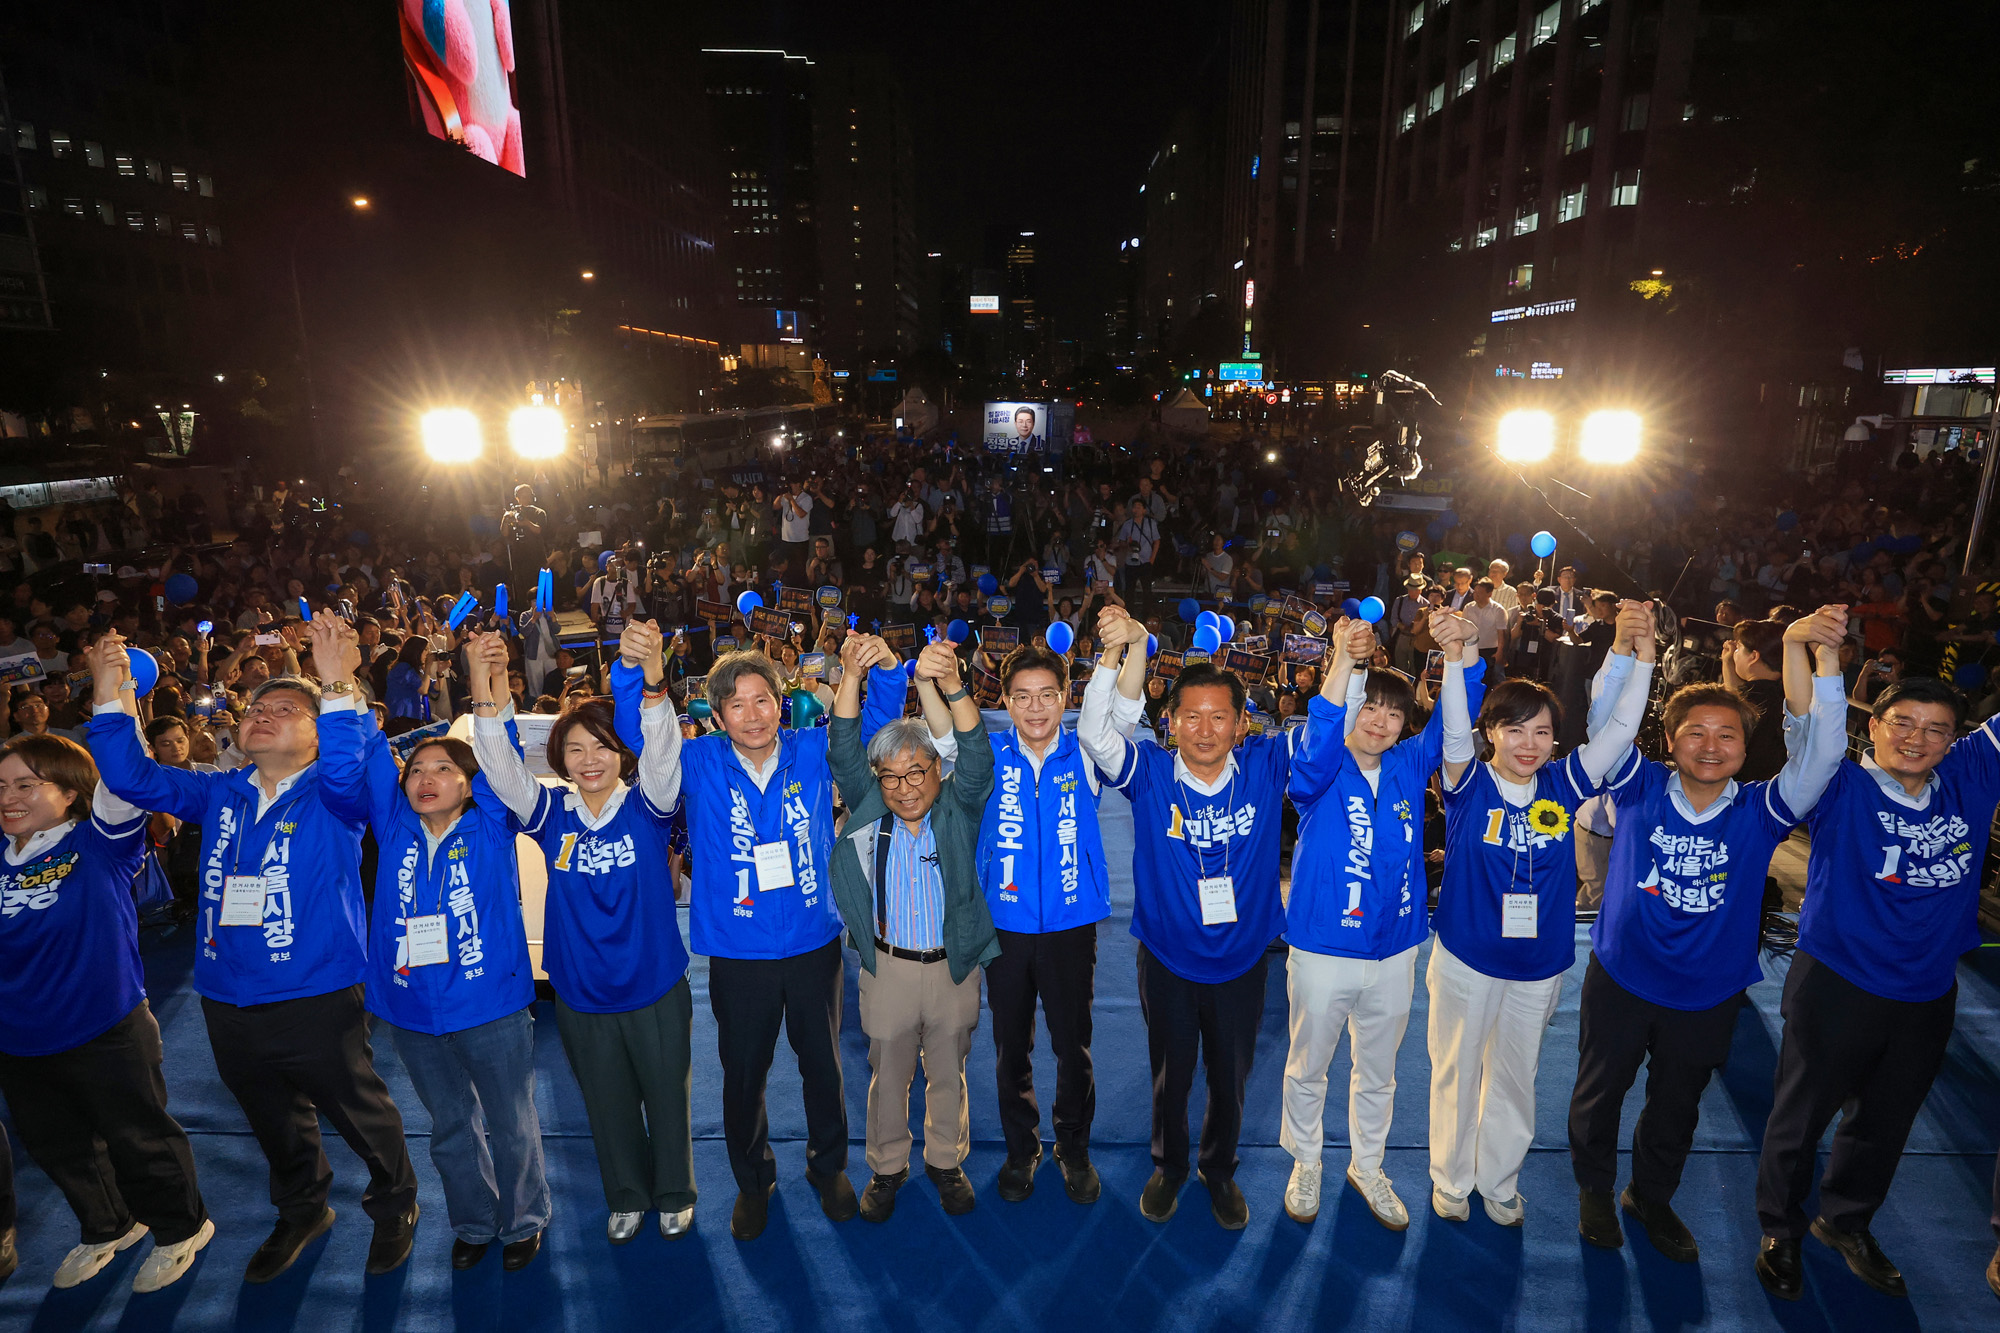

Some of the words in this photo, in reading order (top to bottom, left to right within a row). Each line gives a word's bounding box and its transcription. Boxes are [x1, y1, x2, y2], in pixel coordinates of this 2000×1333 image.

[987, 437, 1019, 450] 정원오
[1034, 434, 1044, 451] 1
[997, 765, 1025, 850] 정원오
[1184, 803, 1256, 848] 민주당
[1195, 804, 1225, 822] 더불어
[1877, 811, 1896, 835] 일
[784, 795, 818, 896] 서울시장
[1057, 793, 1080, 893] 서울시장
[1344, 796, 1374, 881] 정원오
[1483, 808, 1506, 847] 1
[1507, 824, 1566, 852] 민주
[1662, 835, 1714, 856] 잘하는
[1904, 814, 1970, 859] 서울시장
[555, 832, 579, 872] 1
[577, 833, 636, 876] 민주당
[1662, 841, 1729, 877] 서울시장
[1874, 844, 1902, 885] 1
[1905, 852, 1973, 888] 정원오
[733, 868, 755, 906] 1
[999, 854, 1019, 892] 1
[0, 878, 60, 918] 주당
[263, 837, 295, 948] 서울시장
[804, 895, 818, 908] 후보
[1064, 894, 1078, 905] 후보
[1342, 881, 1364, 918] 1
[1660, 883, 1727, 914] 정원오
[448, 860, 484, 966] 서울시장
[733, 907, 754, 918] 민주당
[1341, 919, 1362, 929] 민주당
[270, 951, 292, 963] 후보
[464, 966, 485, 981] 후보
